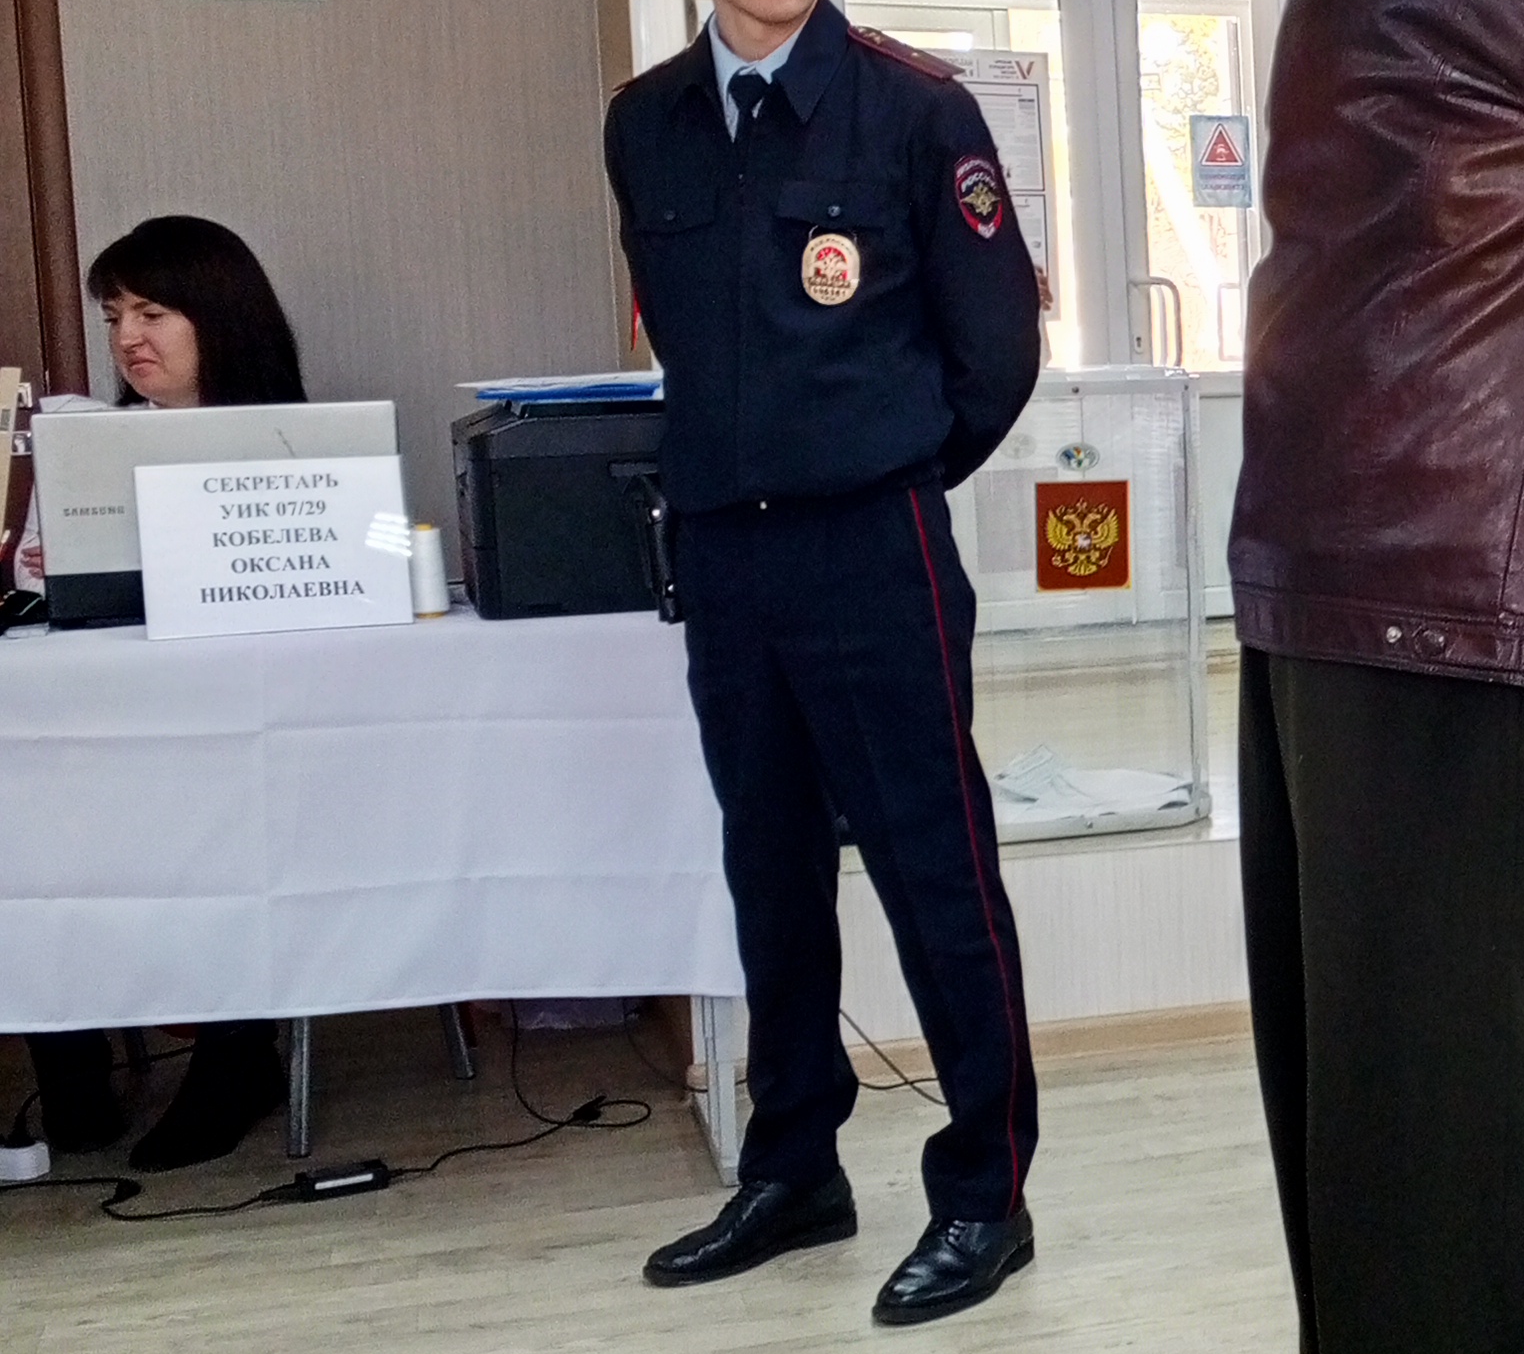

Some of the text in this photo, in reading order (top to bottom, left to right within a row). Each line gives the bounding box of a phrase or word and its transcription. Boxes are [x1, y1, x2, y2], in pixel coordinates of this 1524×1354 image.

[203, 473, 338, 493] СЕКРЕТАРЬ
[220, 500, 326, 520] УИК 07/29
[212, 528, 338, 548] КОБЕЛЕВА
[230, 555, 330, 574] ОКСАНА
[200, 580, 365, 604] НИКОЛАЕВНА
